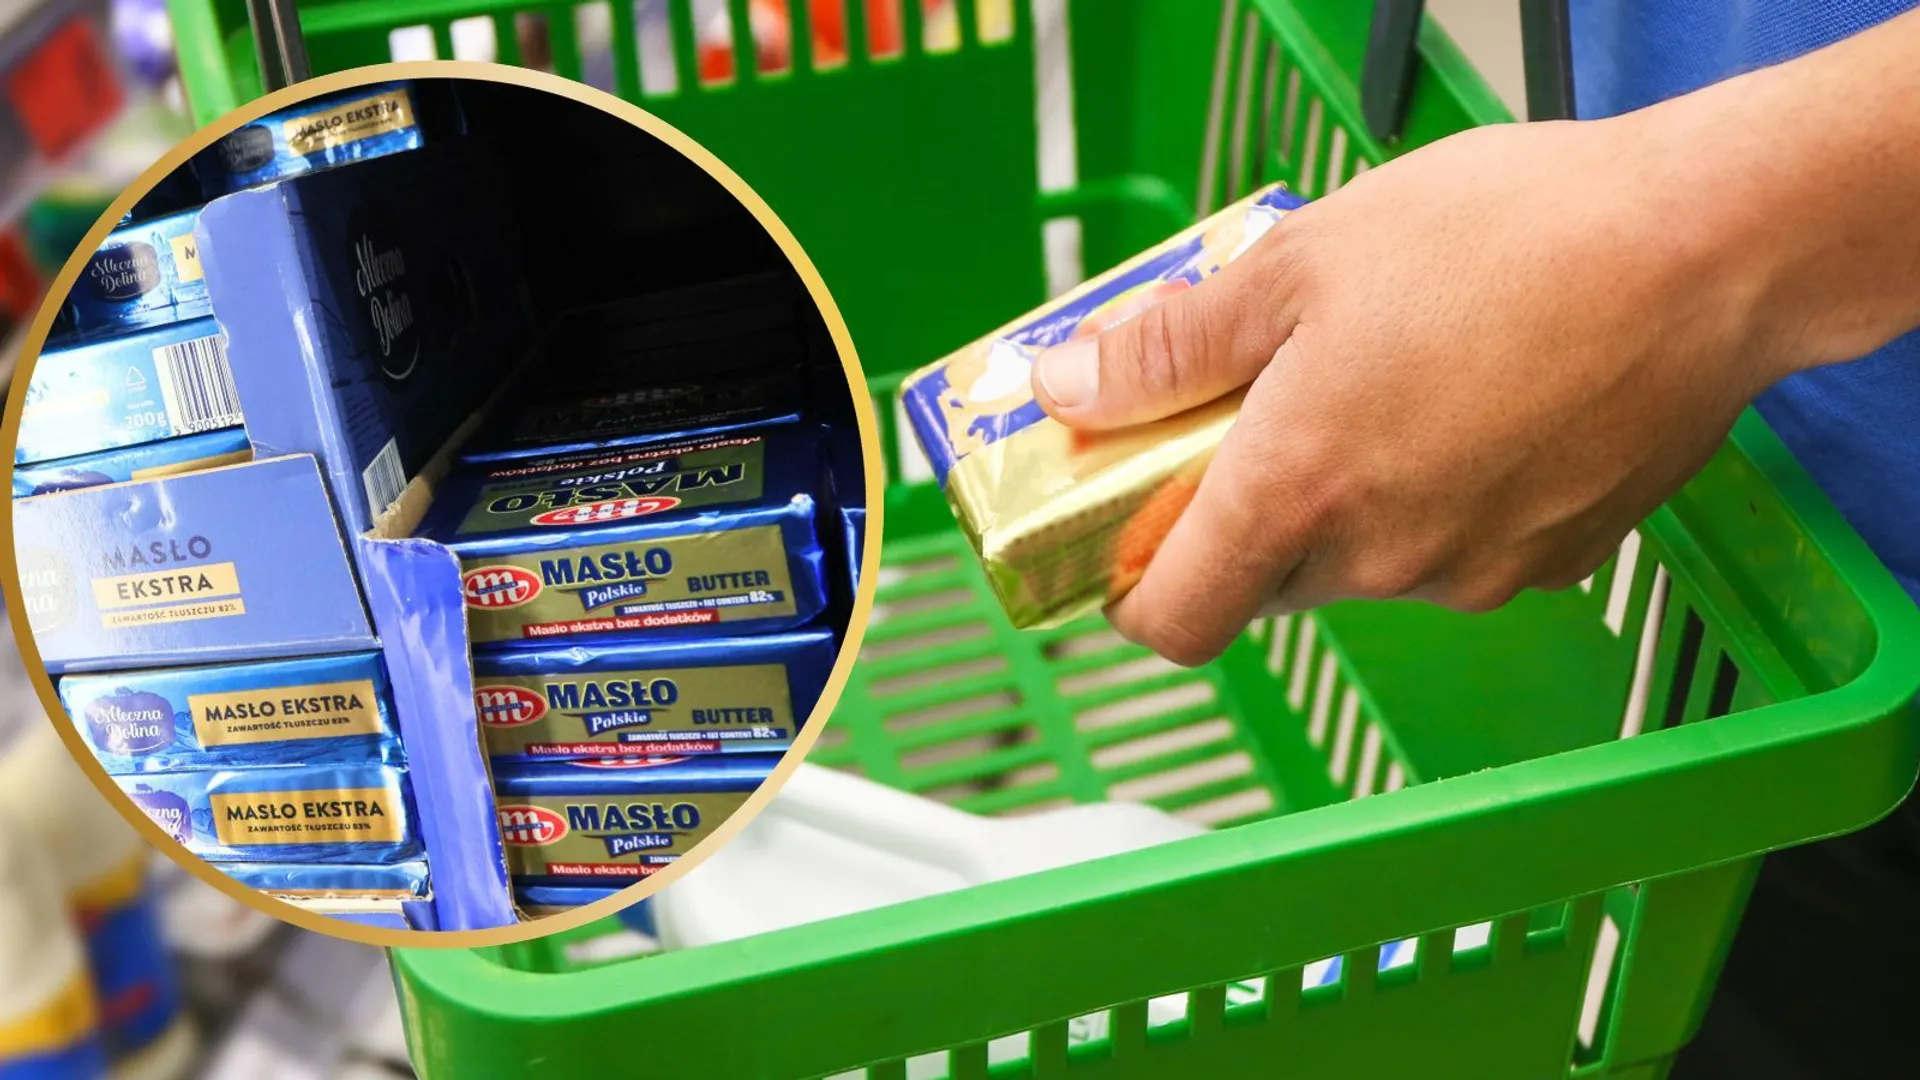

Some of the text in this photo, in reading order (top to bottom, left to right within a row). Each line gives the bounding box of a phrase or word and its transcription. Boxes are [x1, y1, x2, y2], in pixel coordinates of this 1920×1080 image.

[560, 460, 667, 485] Polskie
[487, 462, 746, 514] MASŁO
[102, 535, 212, 570] MASŁO
[540, 547, 672, 586] MASŁO
[116, 572, 214, 600] EKSTRA
[687, 570, 770, 592] BUTTER
[586, 584, 642, 607] Polskie
[570, 620, 614, 633] ekstra
[616, 617, 641, 629] bez
[644, 612, 712, 627] dodatków
[545, 678, 679, 710] MASŁO
[94, 706, 163, 725] Mleczna
[205, 694, 363, 722] MASŁO EKSTRA
[692, 707, 774, 724] BUTTER
[106, 722, 161, 742] Dolina
[227, 721, 282, 733] ZAWARTOŚĆ
[592, 711, 647, 732] Polskie
[572, 744, 616, 754] ekstra
[618, 742, 643, 753] bez
[645, 743, 714, 752] dodatków
[227, 800, 384, 821] MASŁO EKSTRA
[566, 803, 701, 832] MASŁO
[247, 823, 302, 833] ZAWARTOŚĆ
[613, 835, 669, 854] Polskie
[594, 865, 639, 875] ekstra
[640, 865, 661, 875] be
